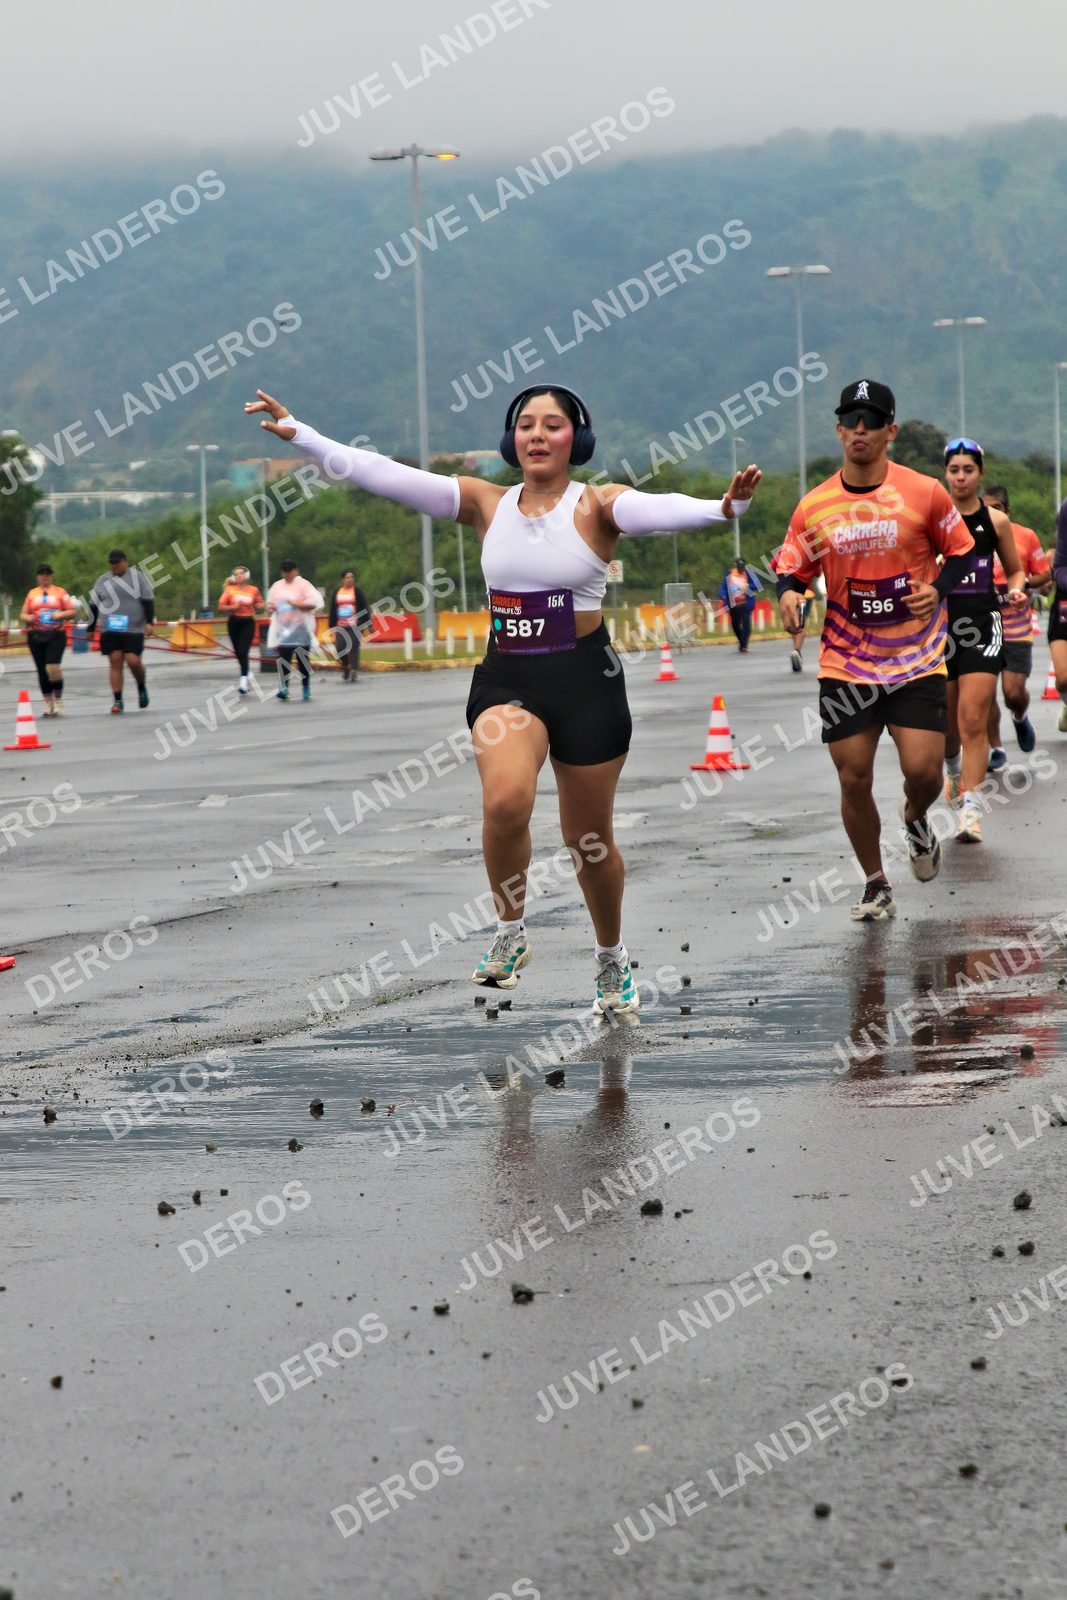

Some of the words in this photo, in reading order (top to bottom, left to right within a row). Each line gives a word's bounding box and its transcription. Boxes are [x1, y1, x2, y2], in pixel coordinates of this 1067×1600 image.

[835, 520, 897, 543] CARRERA
[862, 598, 894, 614] 596
[506, 618, 545, 637] 587
